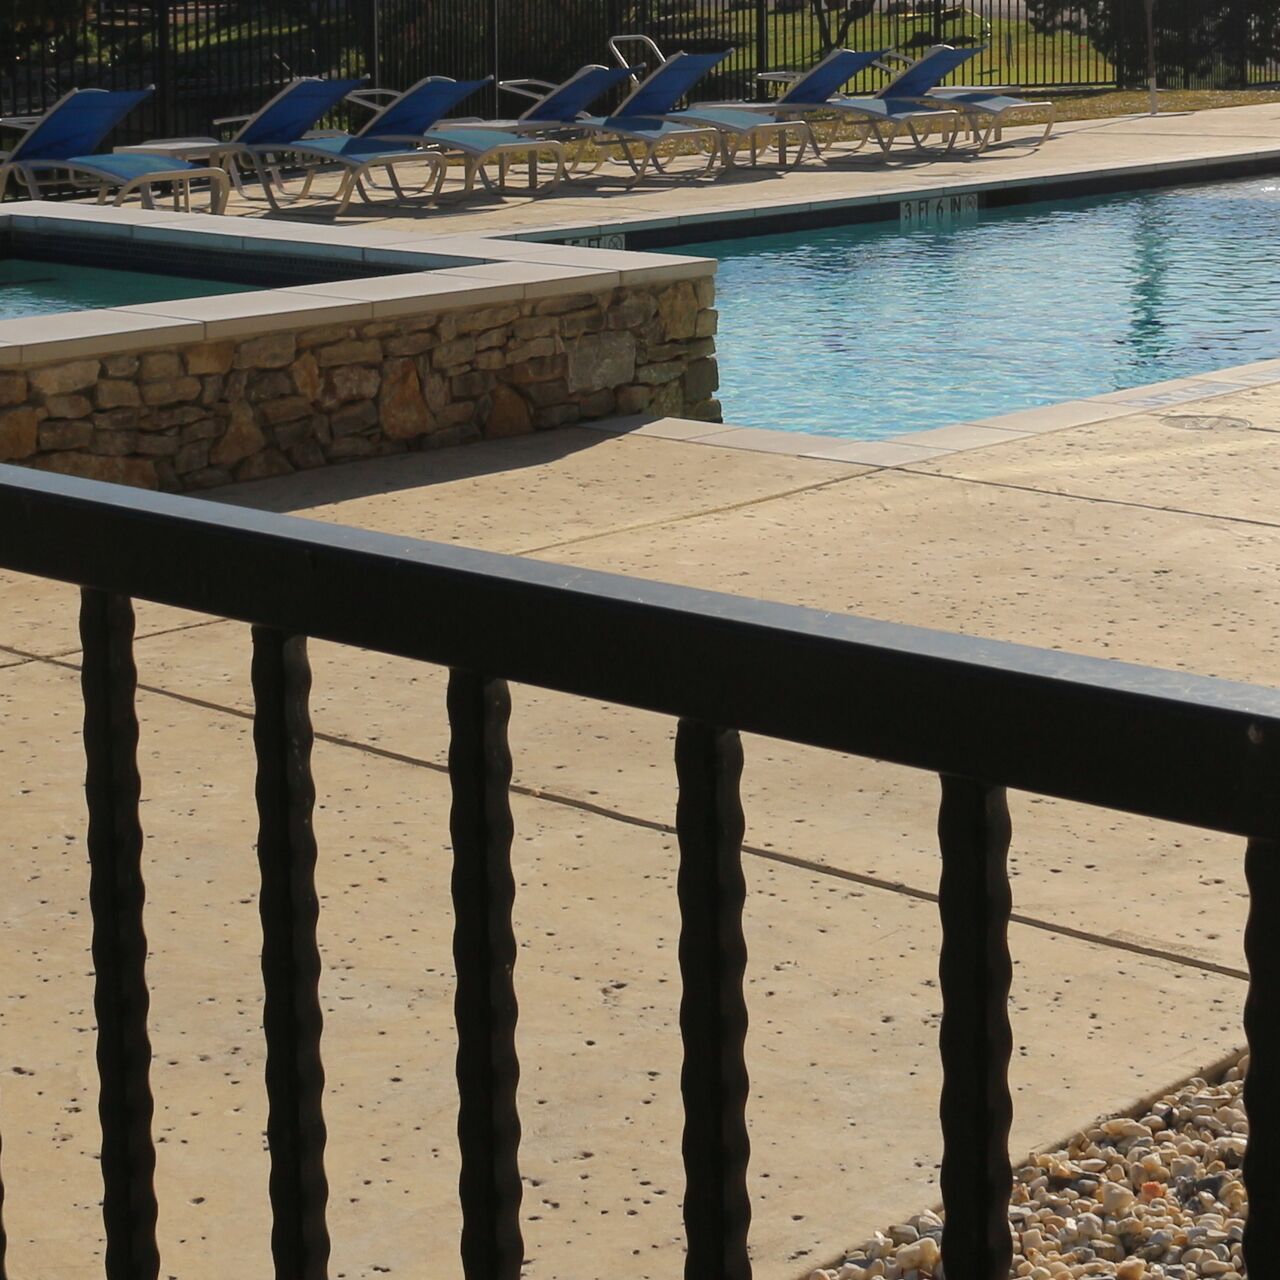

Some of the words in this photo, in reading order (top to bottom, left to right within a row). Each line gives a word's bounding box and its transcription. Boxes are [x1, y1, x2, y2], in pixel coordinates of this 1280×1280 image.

[904, 201, 913, 220] 3
[918, 200, 929, 219] FT
[936, 198, 944, 217] 6
[950, 196, 961, 214] IN
